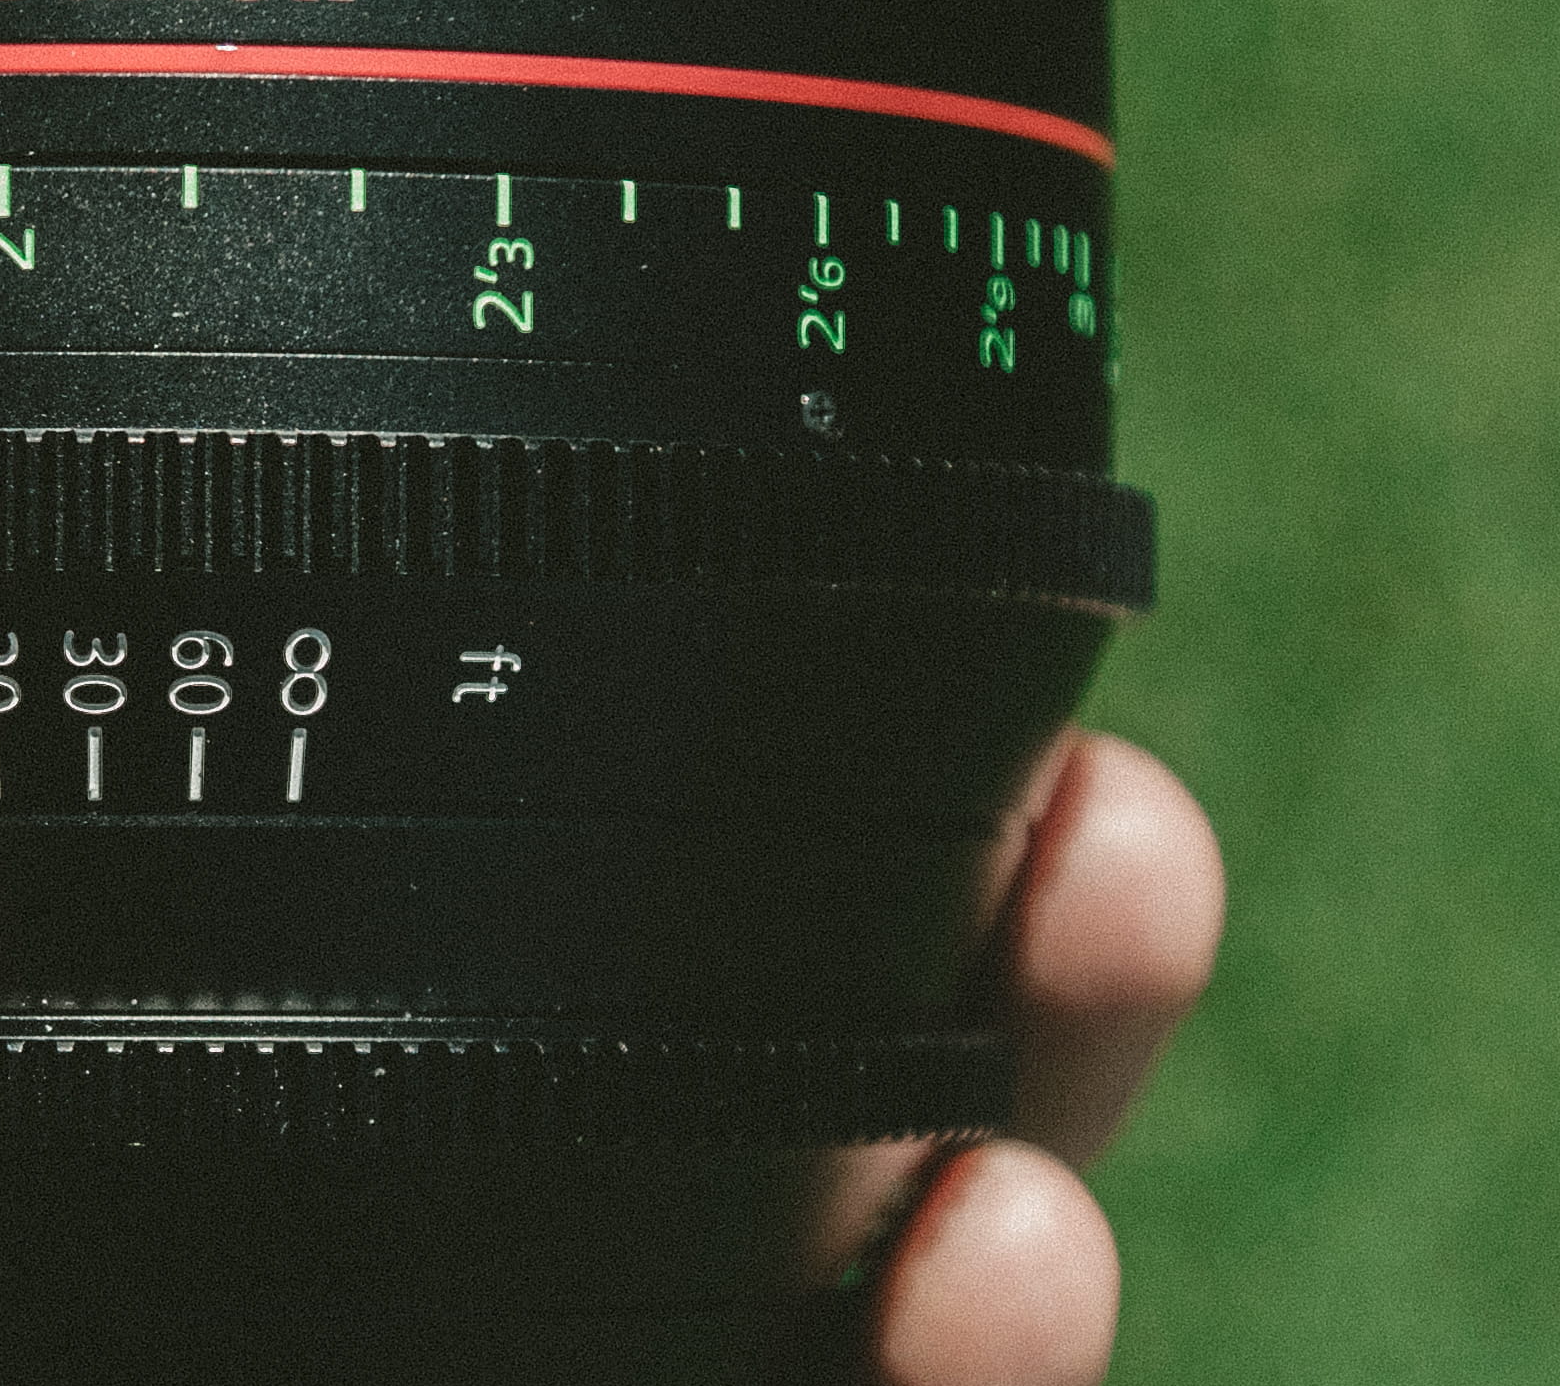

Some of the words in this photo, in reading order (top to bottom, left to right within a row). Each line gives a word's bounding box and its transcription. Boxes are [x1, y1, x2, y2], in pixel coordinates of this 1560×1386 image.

[63, 629, 128, 716] 30
[168, 630, 234, 716] 60
[450, 644, 523, 705] ft
